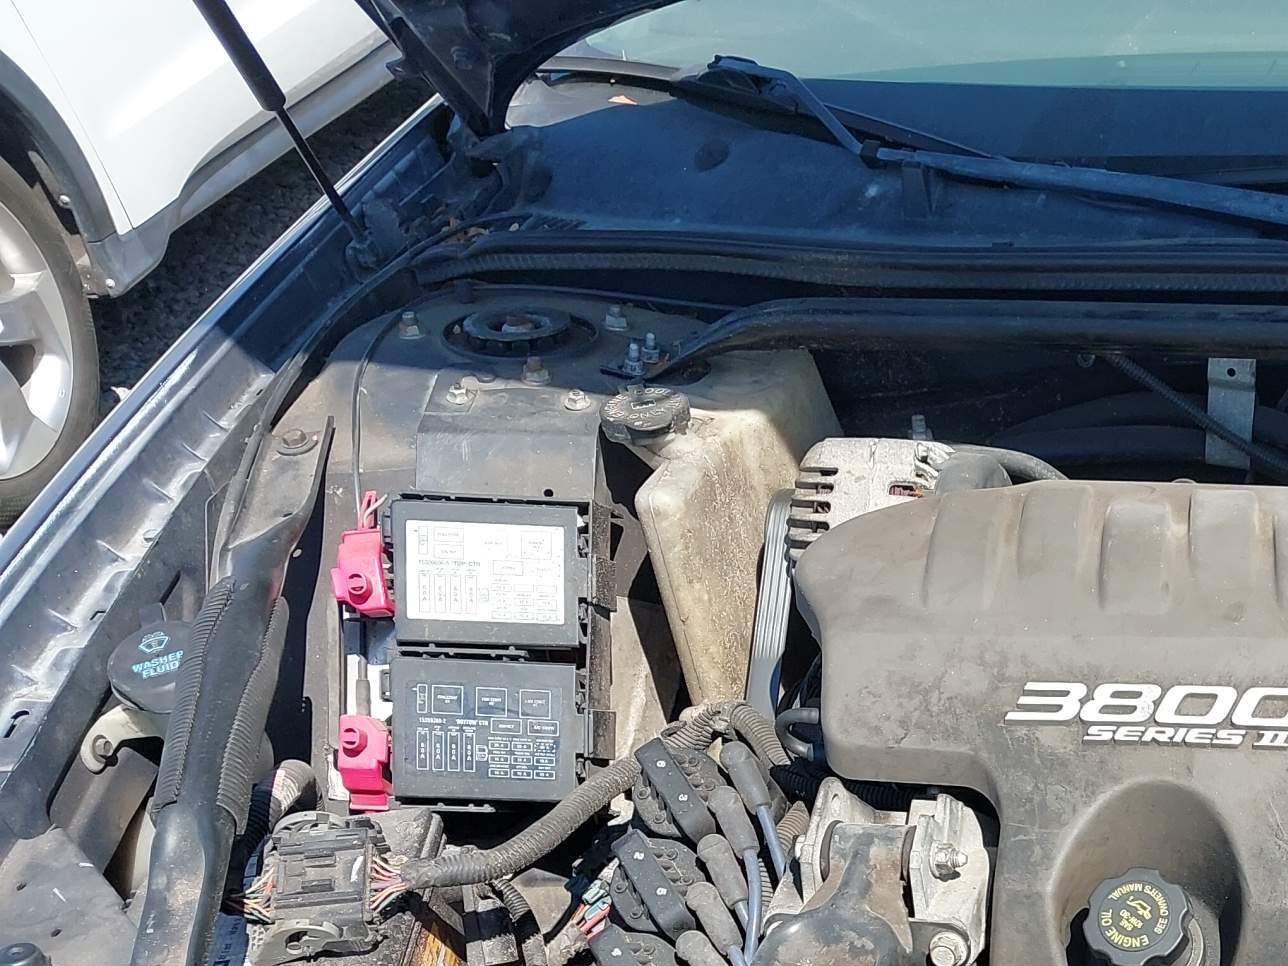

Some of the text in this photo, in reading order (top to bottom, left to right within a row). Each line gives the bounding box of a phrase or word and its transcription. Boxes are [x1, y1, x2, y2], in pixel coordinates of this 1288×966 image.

[132, 650, 184, 673] WASHER
[142, 660, 180, 680] FLUID
[1083, 725, 1247, 748] SERIES
[1108, 883, 1168, 934] SEE OWNER'S MANUAL
[1101, 909, 1150, 947] ENGINE OIL
[1120, 919, 1134, 931] SAE
